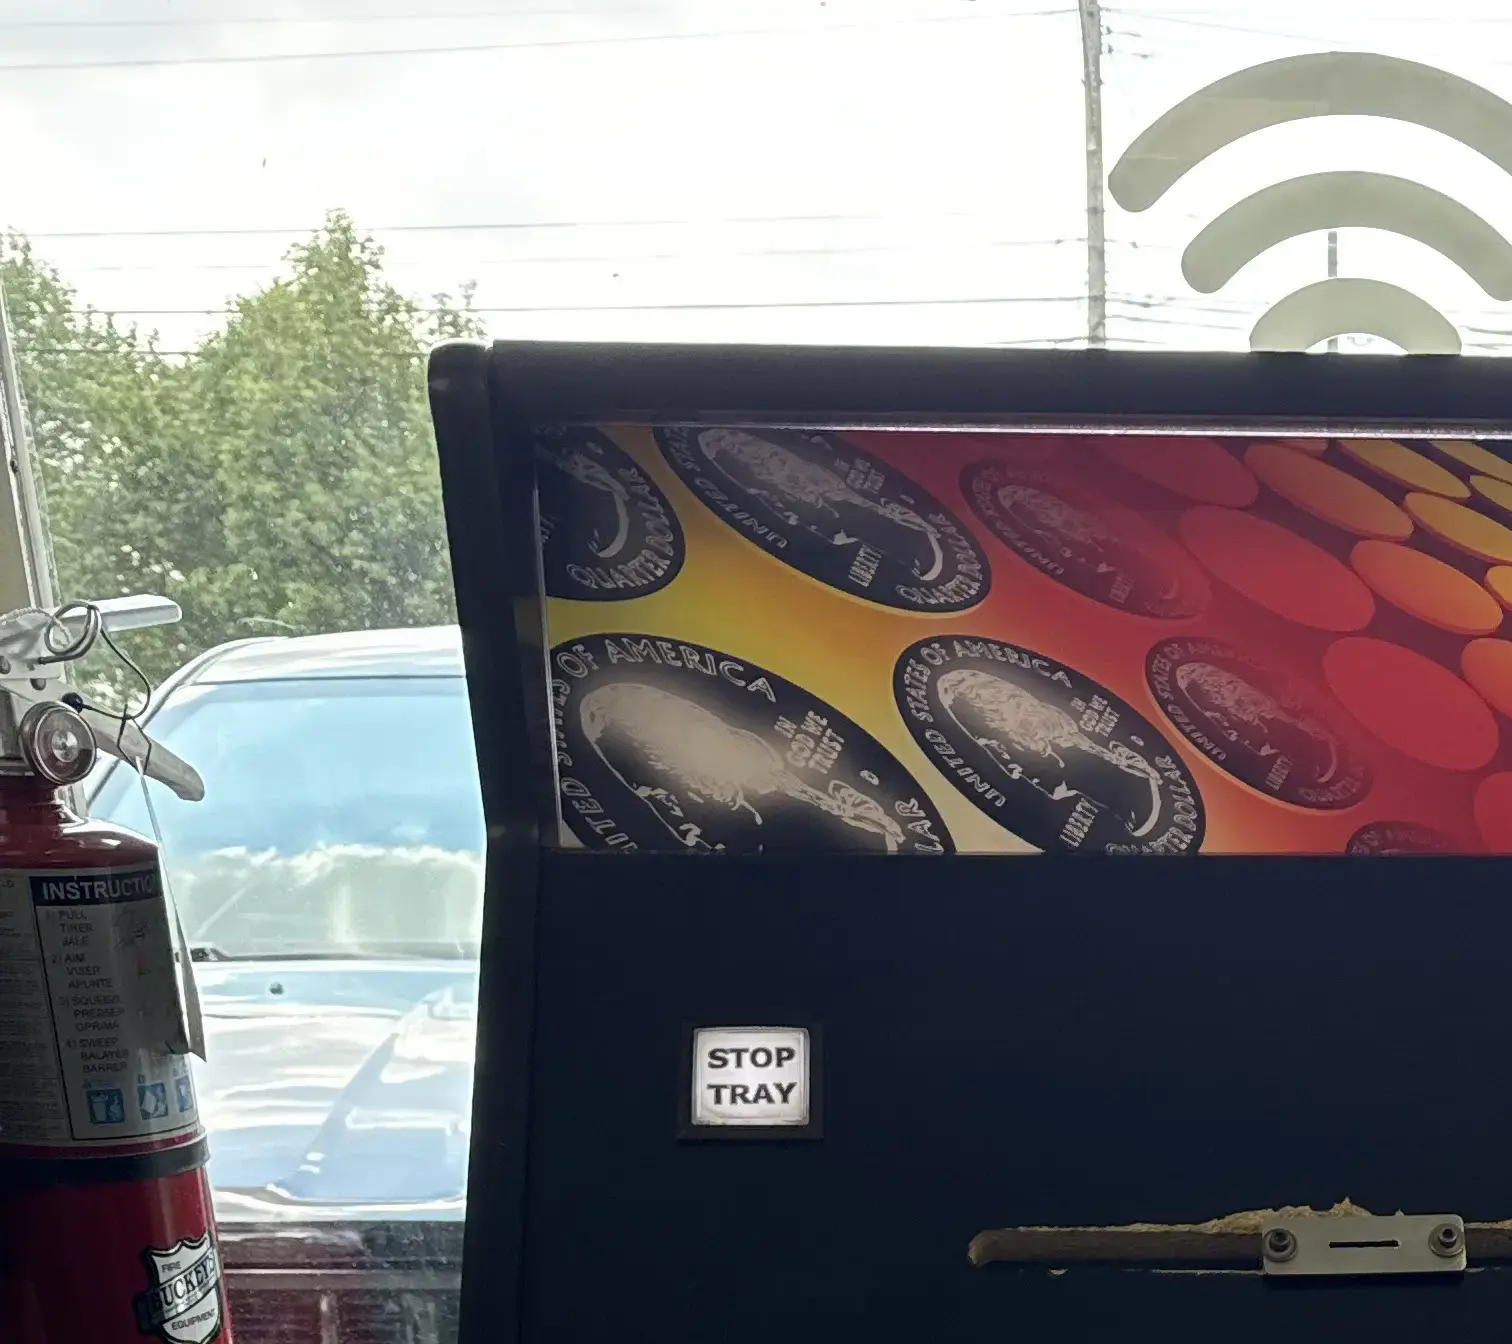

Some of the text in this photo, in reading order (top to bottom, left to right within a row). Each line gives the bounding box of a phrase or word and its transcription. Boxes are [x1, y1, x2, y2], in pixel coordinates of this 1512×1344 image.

[566, 549, 671, 589] QUARTER
[557, 643, 600, 680] OF
[604, 637, 777, 703] AMERICA
[953, 639, 1073, 689] AMERICA
[903, 657, 934, 723] STATES
[925, 727, 1007, 808] UNITED
[561, 777, 638, 854] ITED
[42, 876, 153, 901] INSTRUCTIO
[82, 1061, 129, 1074] BARRER
[707, 1046, 797, 1069] STOP
[706, 1082, 798, 1105] TRAY
